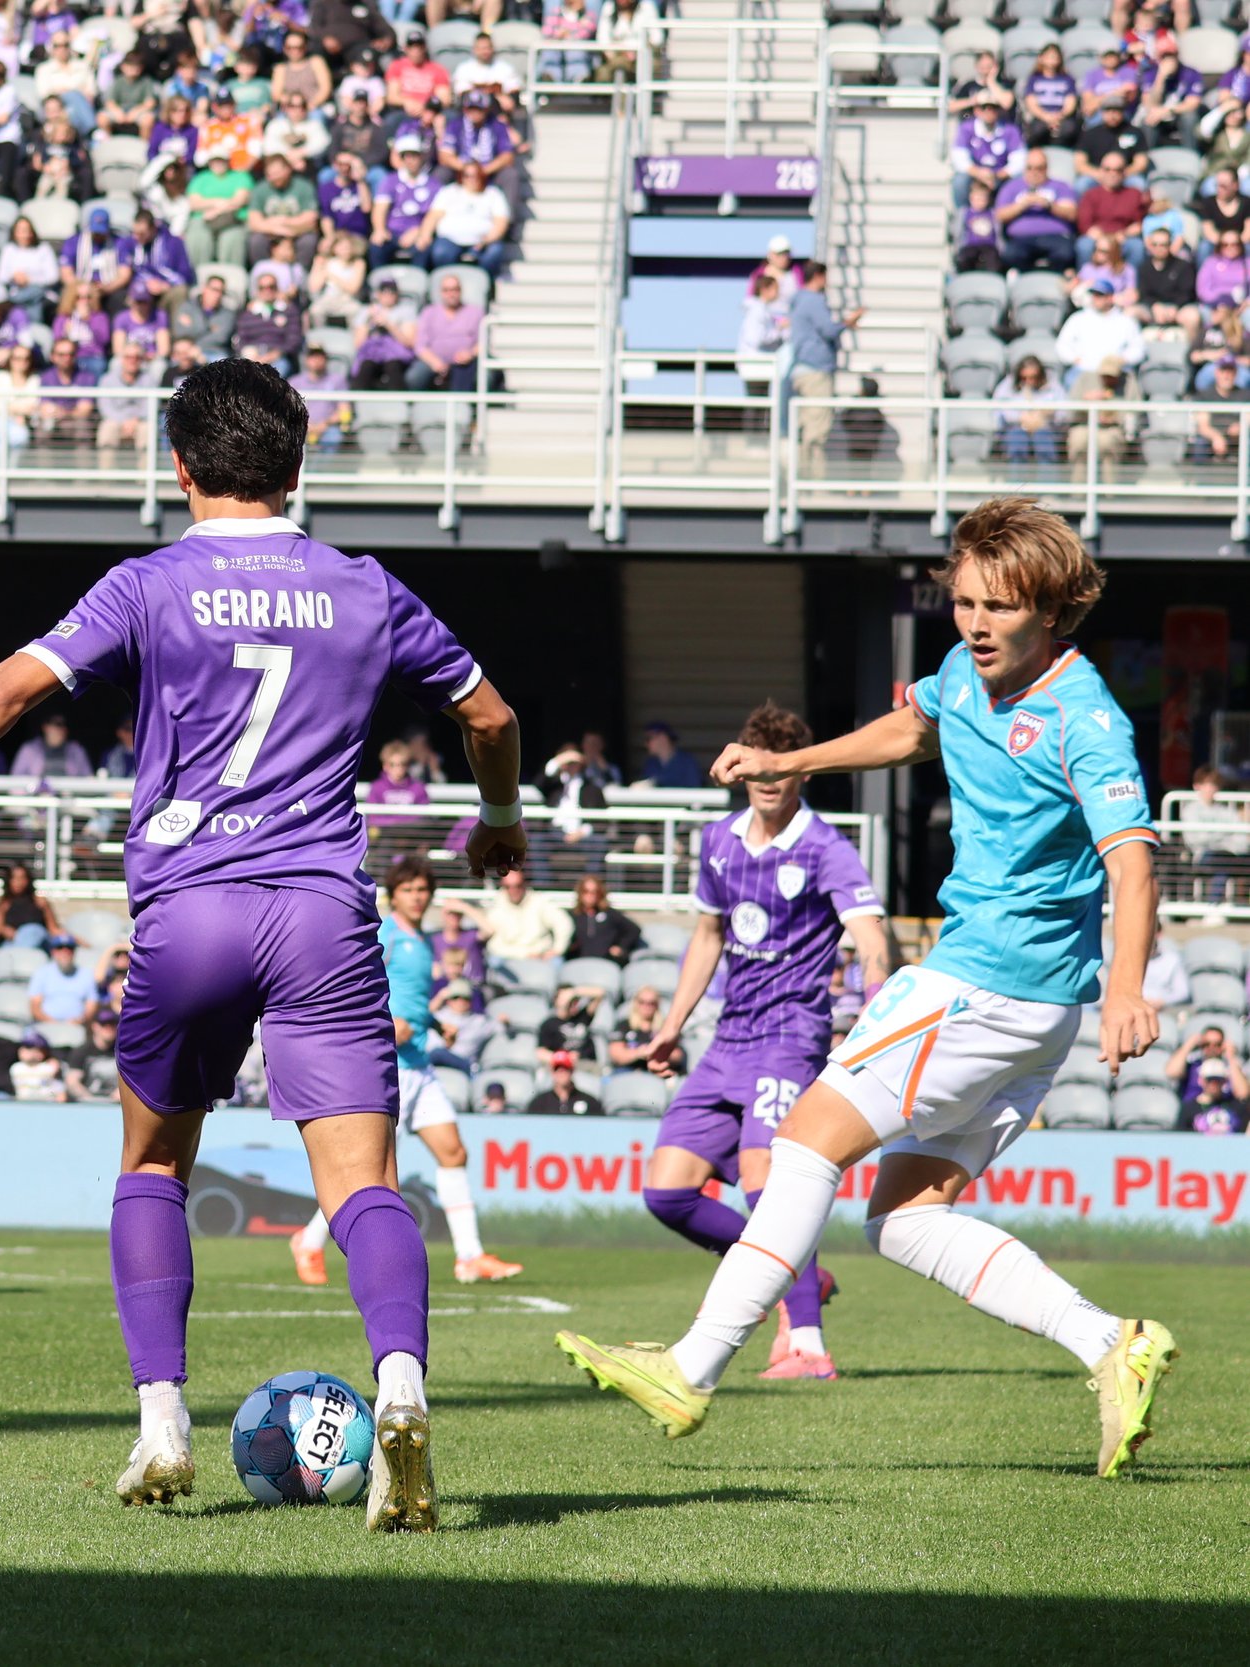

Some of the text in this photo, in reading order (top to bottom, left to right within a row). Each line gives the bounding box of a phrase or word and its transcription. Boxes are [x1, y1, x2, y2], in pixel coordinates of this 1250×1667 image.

[775, 159, 818, 191] 226
[229, 554, 303, 567] JEFFERSON
[191, 588, 334, 629] SERRANO
[217, 643, 293, 788] 7
[208, 799, 307, 836] TOYA
[483, 1141, 721, 1200] Mowi
[1113, 1157, 1247, 1225] Play
[308, 1386, 347, 1465] SELECT
